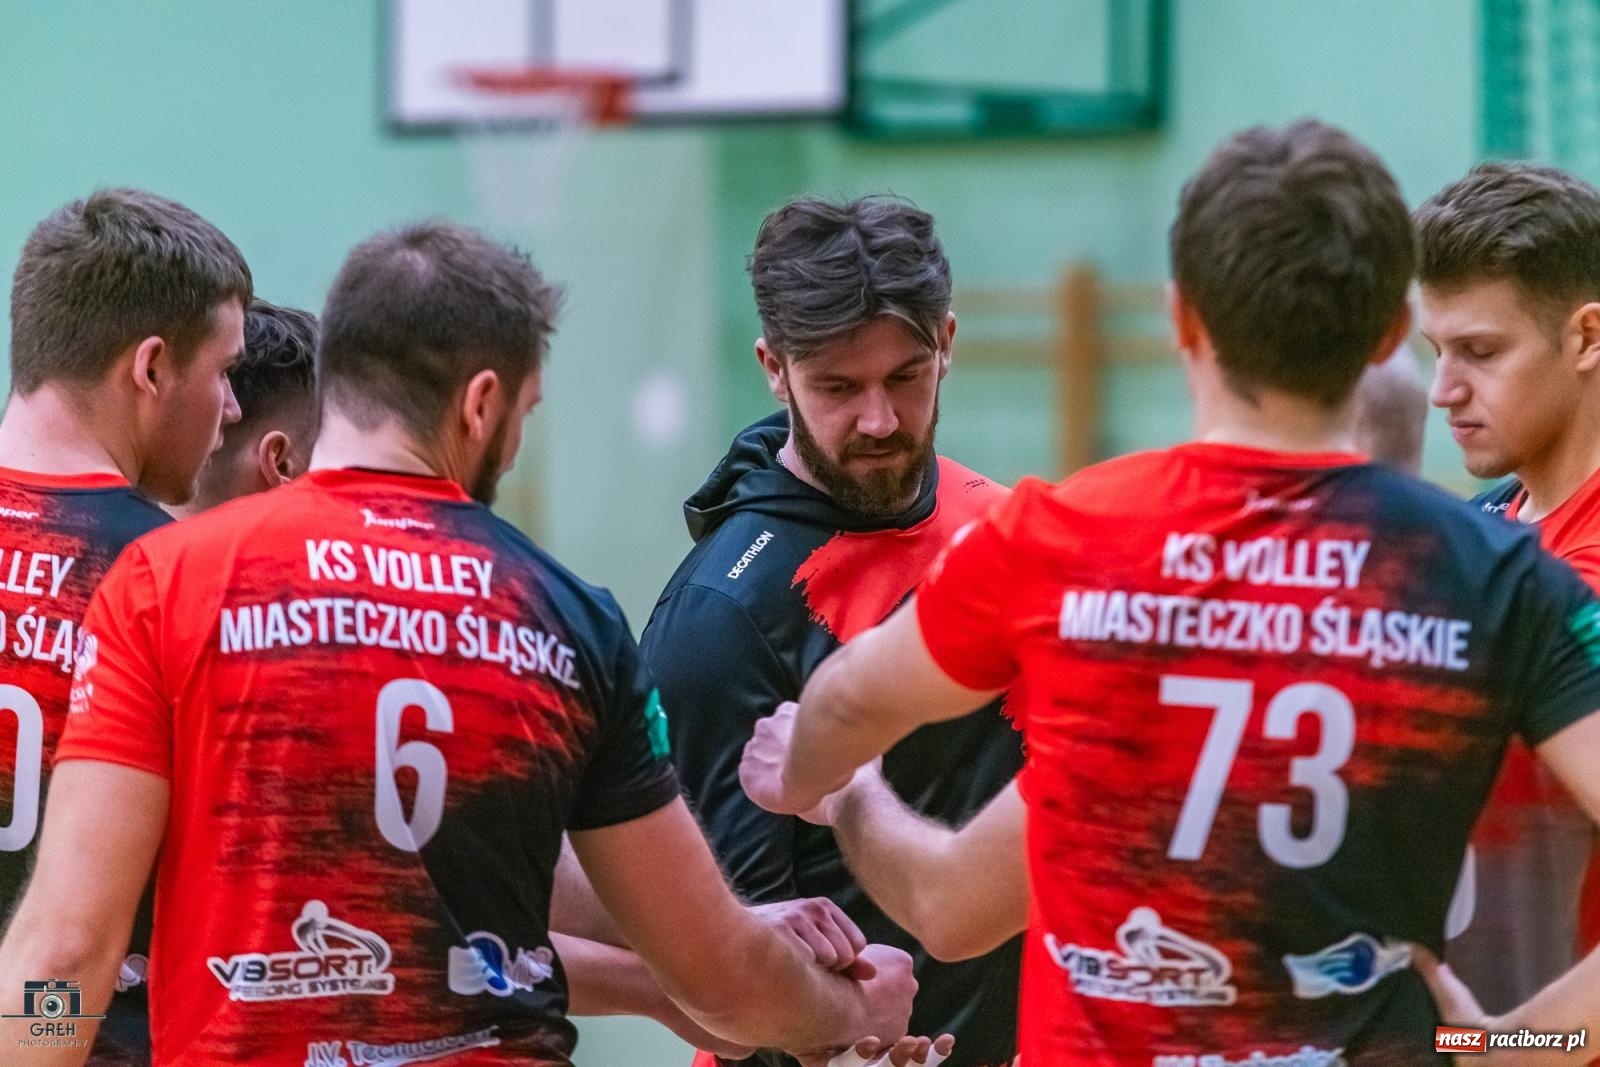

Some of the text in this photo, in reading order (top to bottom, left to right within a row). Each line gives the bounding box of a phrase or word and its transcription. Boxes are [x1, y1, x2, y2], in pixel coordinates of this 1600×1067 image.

[305, 539, 493, 599] KS VOLLEY
[727, 530, 775, 579] DECATHLON
[1161, 531, 1371, 589] KS VOLLEY
[13, 606, 73, 673] ŚLĄ
[219, 597, 448, 655] MIASTECZKO
[1058, 590, 1472, 671] MIASTECZKO ŚLĄSKIE
[375, 678, 454, 852] 6
[1158, 674, 1356, 869] 73
